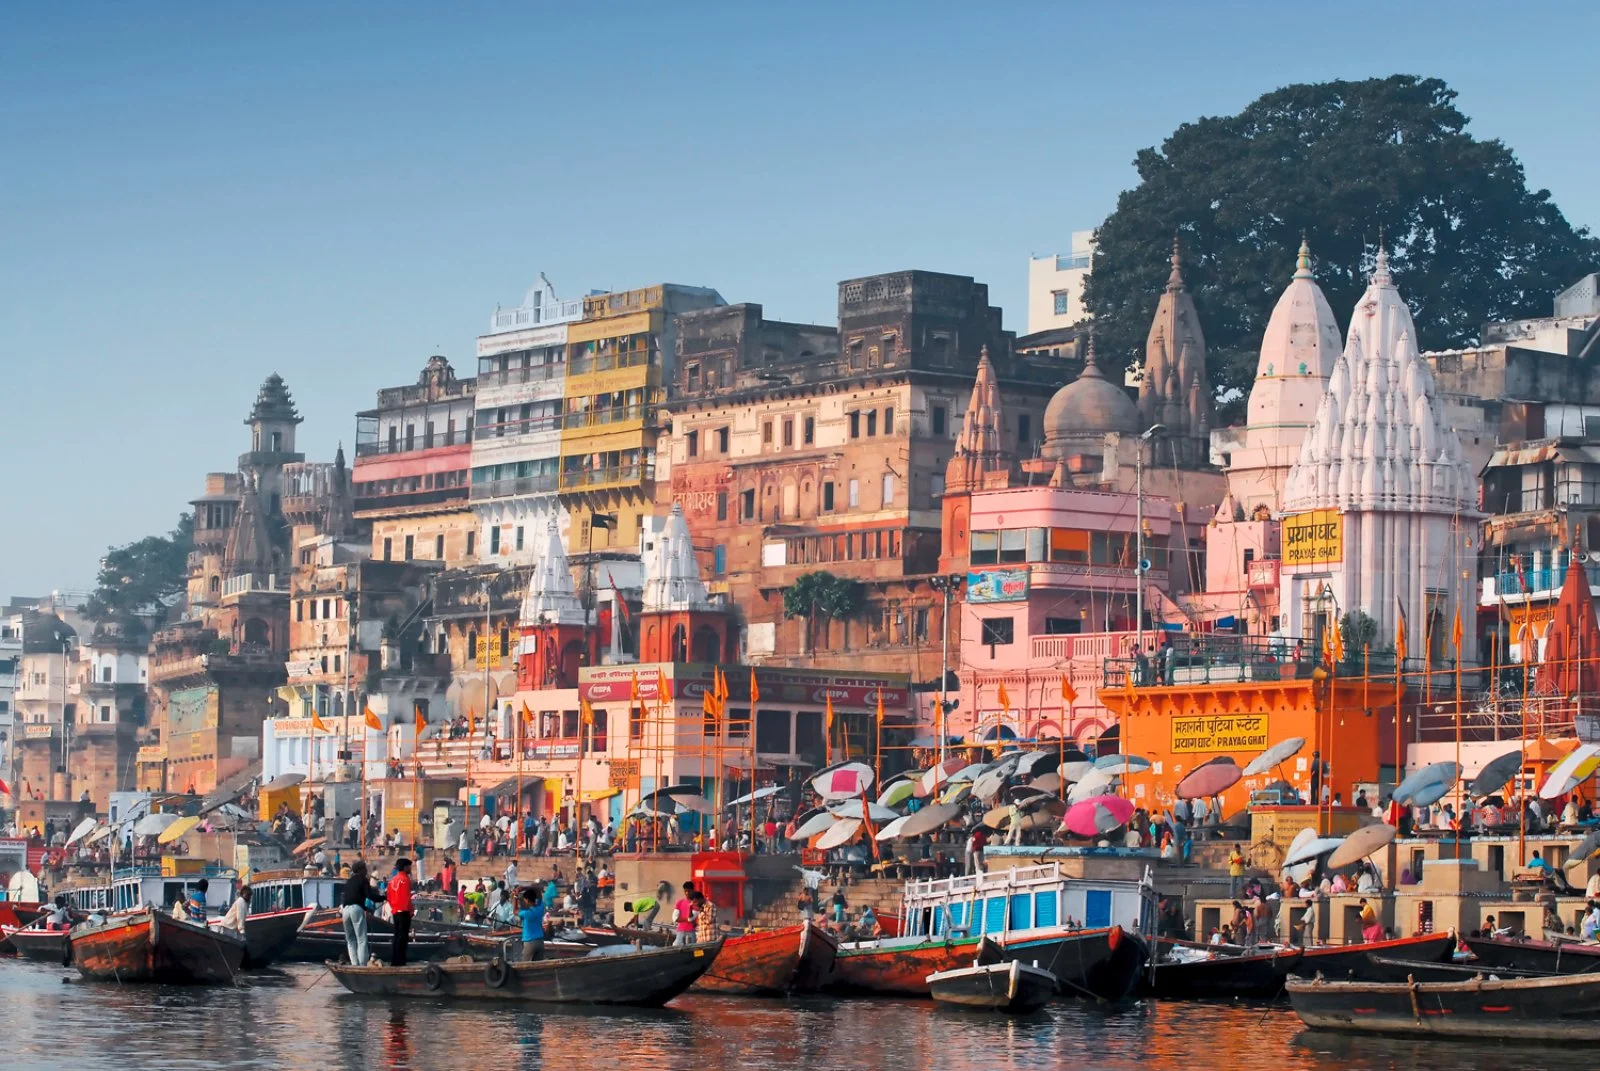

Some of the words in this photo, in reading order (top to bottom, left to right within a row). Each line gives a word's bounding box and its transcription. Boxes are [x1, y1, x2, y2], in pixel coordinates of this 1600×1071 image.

[1318, 523, 1337, 541] घाट
[1289, 548, 1316, 561] PRAYAG
[1318, 546, 1337, 558] GHAT
[640, 684, 658, 692] RUPA
[1217, 736, 1246, 747] PRAYAG
[1248, 735, 1266, 745] GHAT
